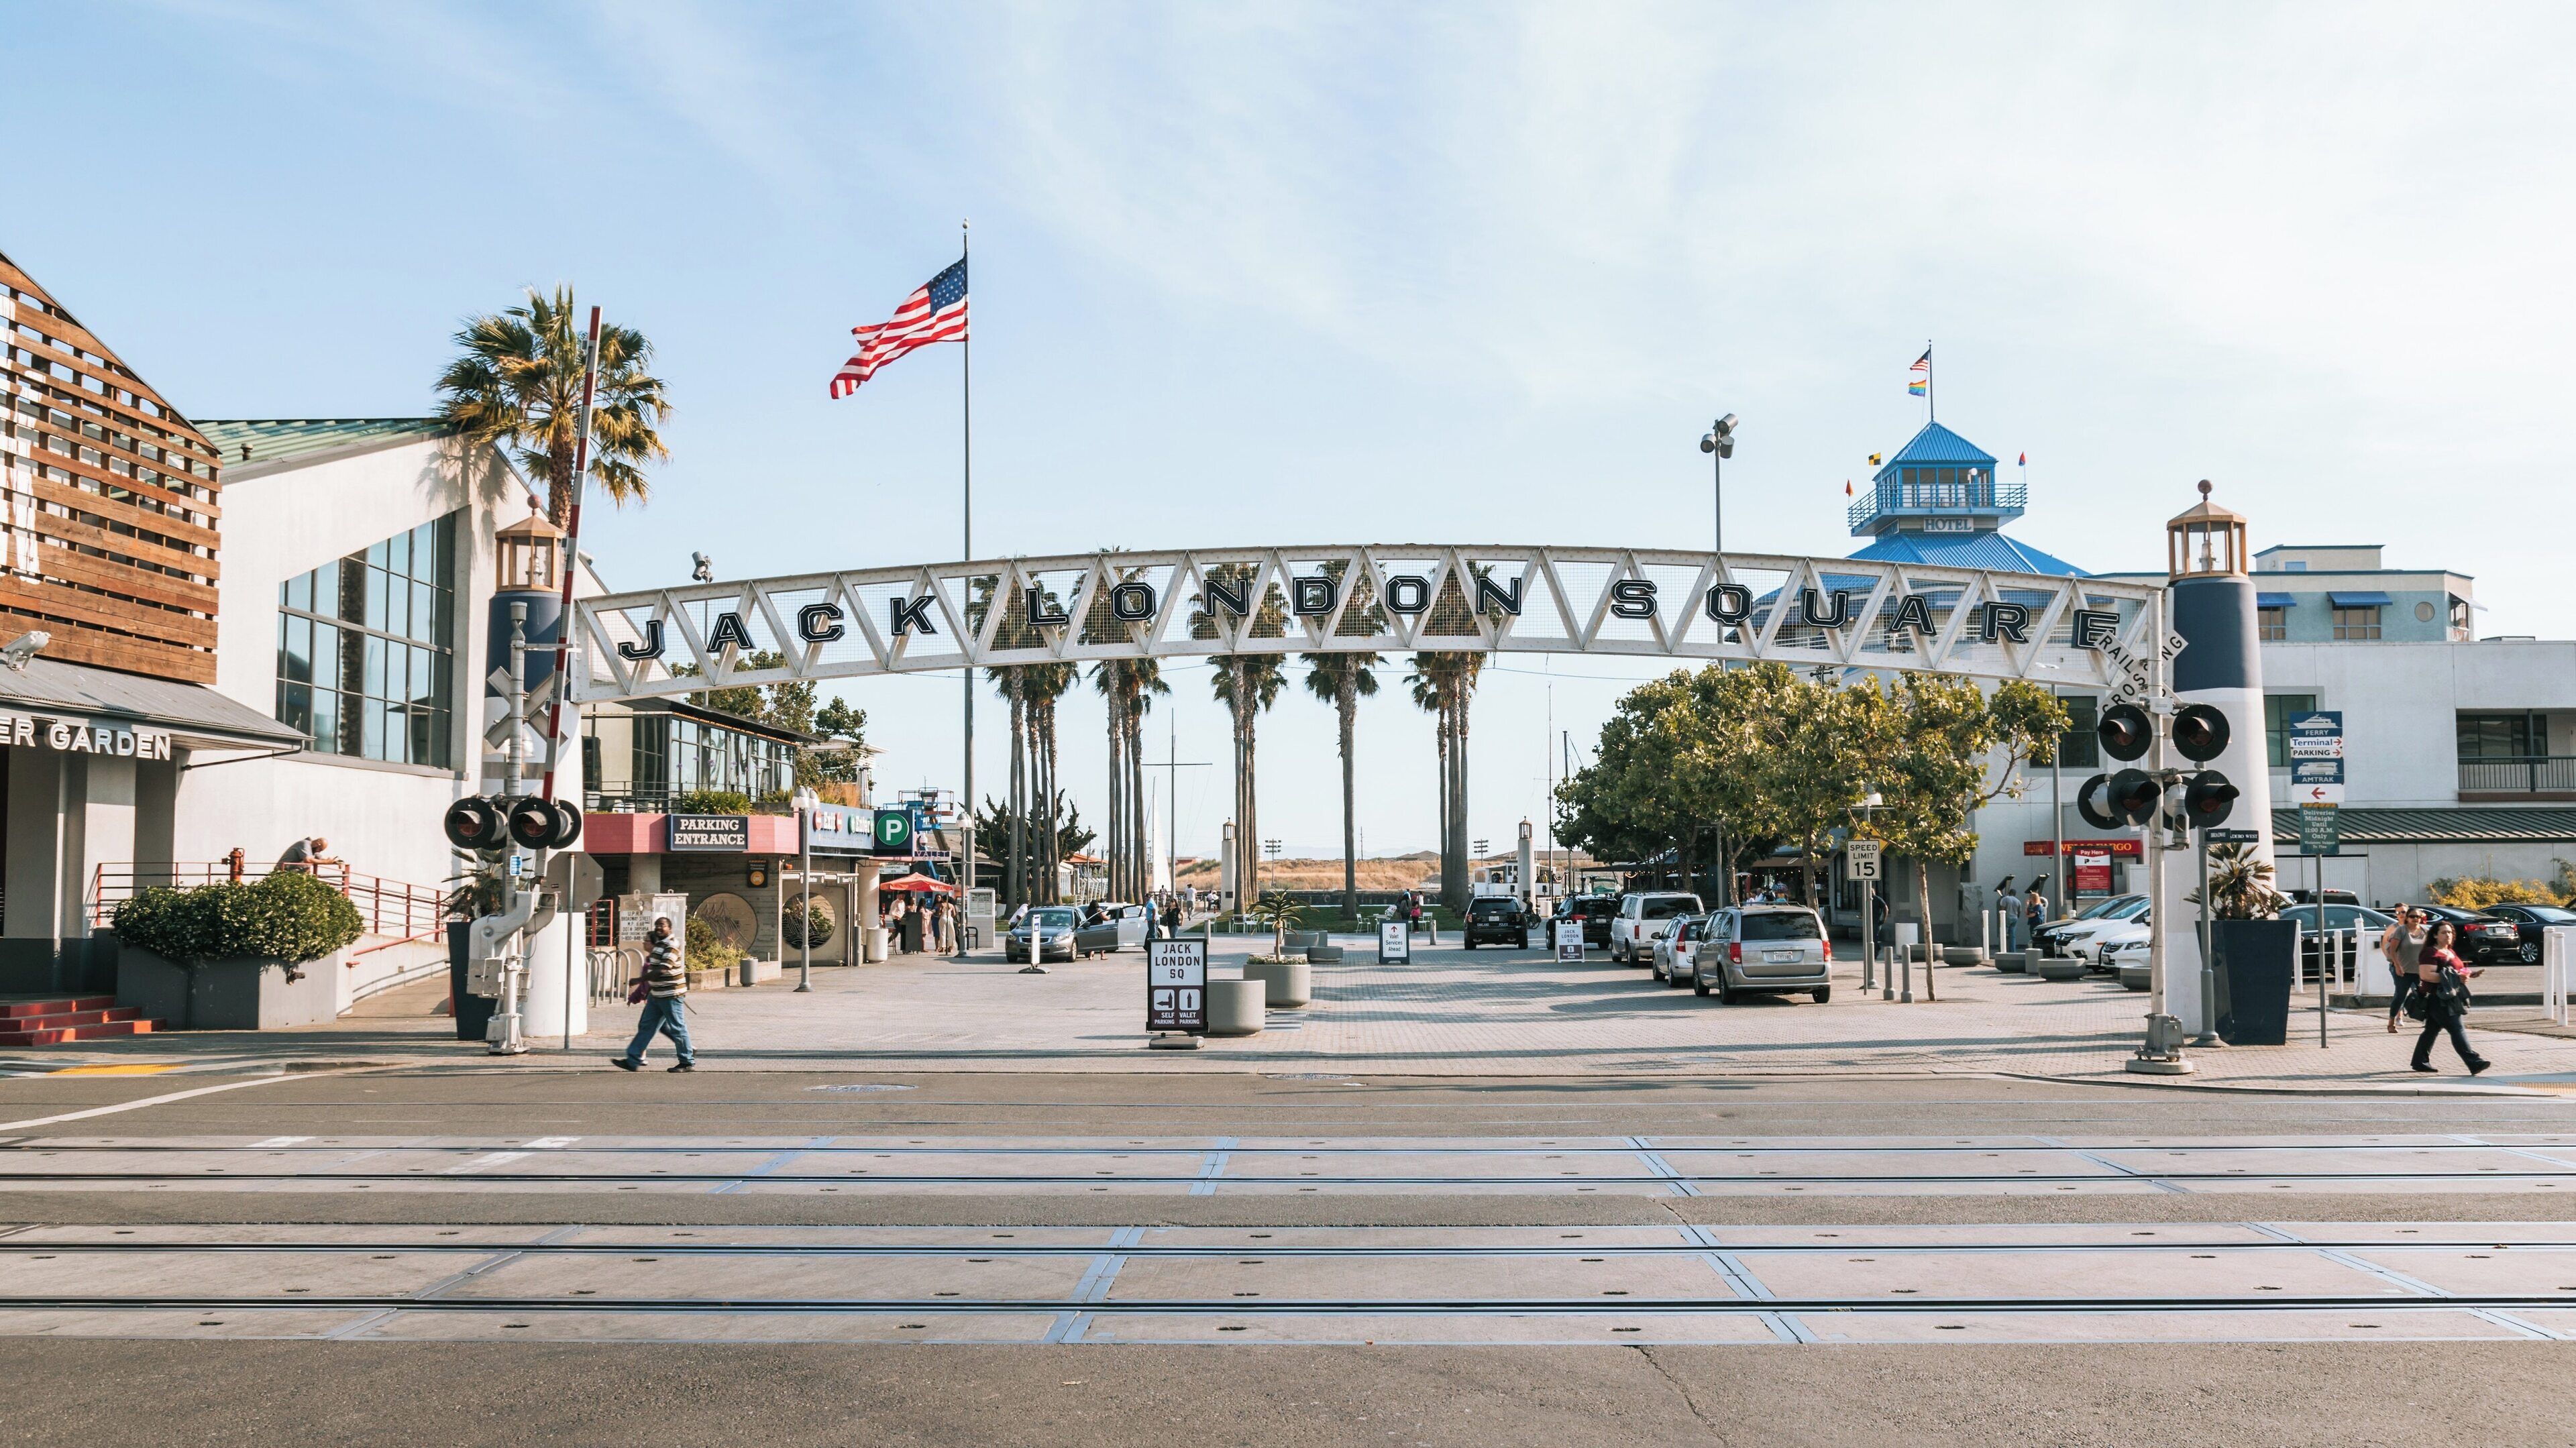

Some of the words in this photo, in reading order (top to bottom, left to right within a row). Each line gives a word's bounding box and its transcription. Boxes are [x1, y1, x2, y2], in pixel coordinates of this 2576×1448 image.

[1925, 518, 1972, 531] HOTEL
[618, 595, 938, 661] JACK
[1026, 575, 1521, 626] LONDON
[1611, 579, 2120, 651] SQUARE
[2098, 634, 2134, 674] RAIL
[2102, 636, 2182, 714] CROSNG
[0, 716, 36, 747] ER
[47, 723, 171, 761] GARDEN
[2292, 738, 2332, 746] Terminal
[680, 819, 739, 830] PARKING
[886, 820, 902, 841] P
[674, 833, 745, 845] ENTRANCE
[1855, 862, 1875, 877] 15
[1163, 944, 1191, 954] JACK
[1155, 956, 1200, 966] LONDON
[1170, 968, 1185, 979] SQ
